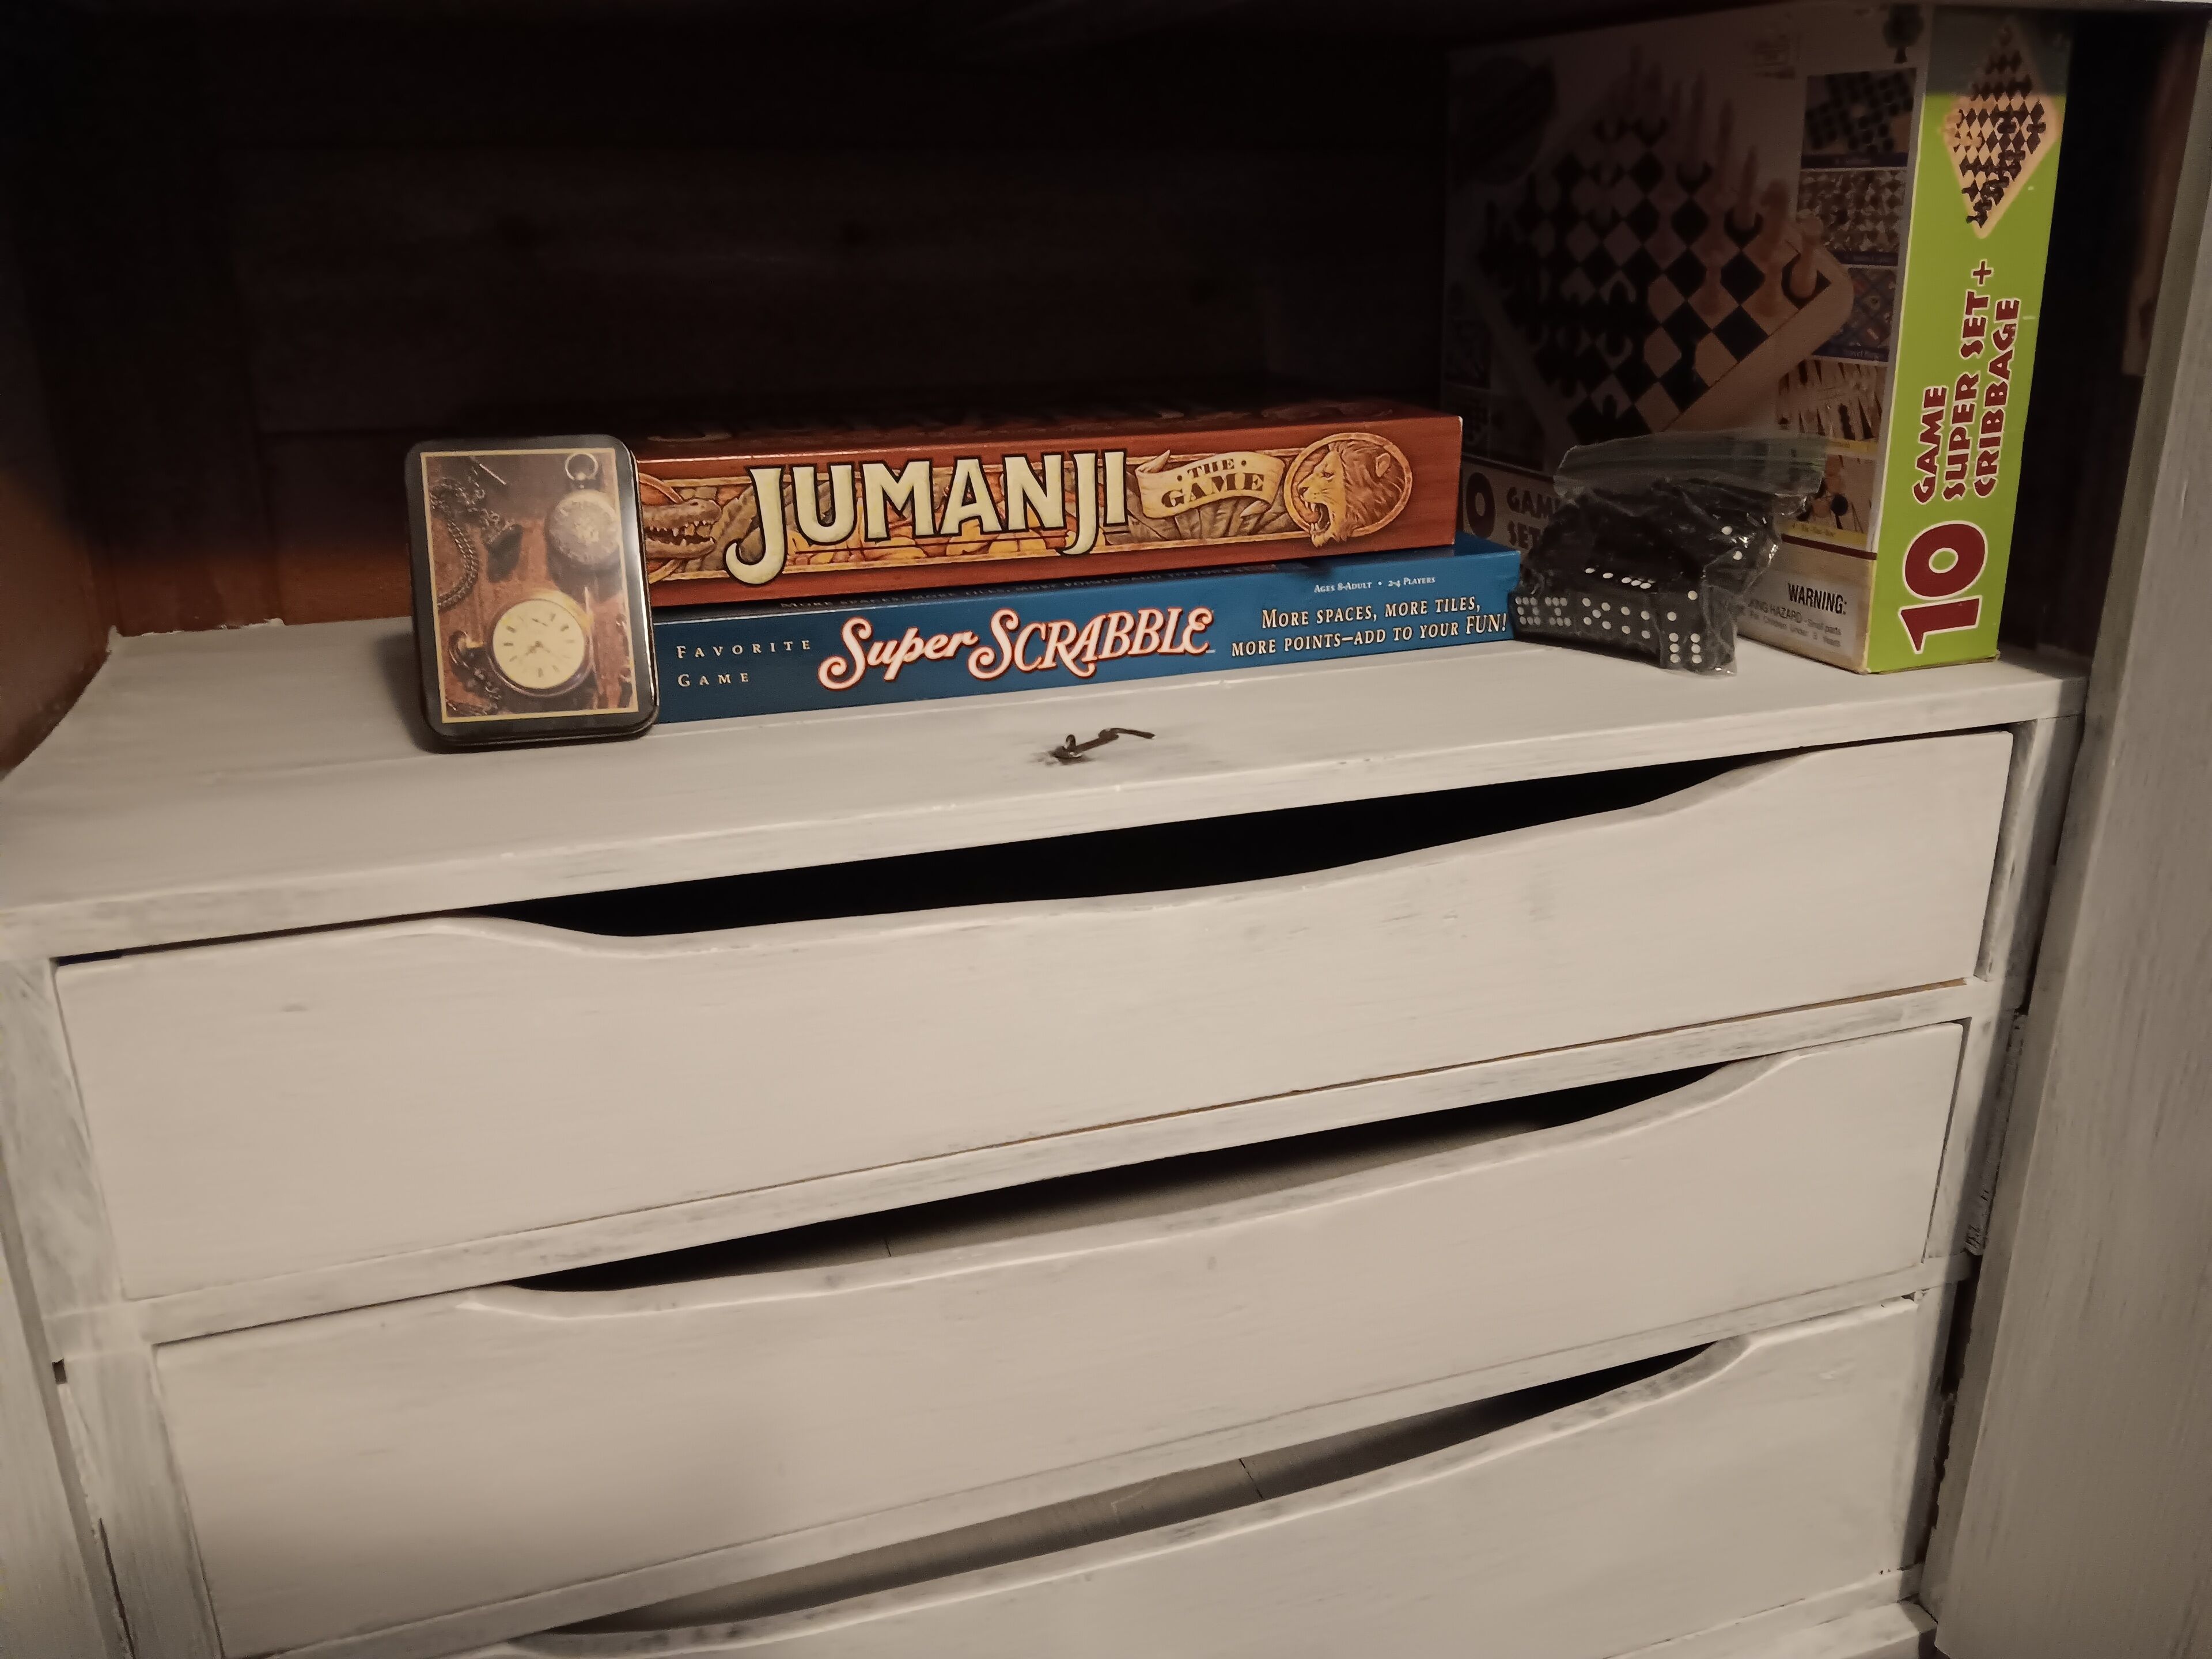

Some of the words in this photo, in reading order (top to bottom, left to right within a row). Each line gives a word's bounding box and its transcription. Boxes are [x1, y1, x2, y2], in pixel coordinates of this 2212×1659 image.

[1974, 298, 2021, 498] CRIBBAGE
[1912, 385, 1949, 505] GAME
[1942, 370, 1980, 501] SUPER
[1161, 472, 1264, 507] GAME
[1187, 459, 1234, 478] THE
[725, 449, 1128, 585] JUMANJI
[1787, 582, 1847, 615] WARNING:
[1899, 520, 1988, 654] 10
[1262, 608, 1309, 628] MORE
[1316, 605, 1377, 624] SPACES,
[1384, 600, 1427, 618] MORE
[1435, 596, 1480, 613] TILES,
[676, 639, 812, 658] FAVORITE
[818, 616, 979, 690] Super
[967, 605, 1214, 679] SCRABBLE
[1231, 639, 1277, 657] MORE
[1392, 626, 1413, 642] TO
[1419, 621, 1459, 638] YOUR
[1465, 613, 1508, 635] FUN!
[677, 672, 751, 688] GAME
